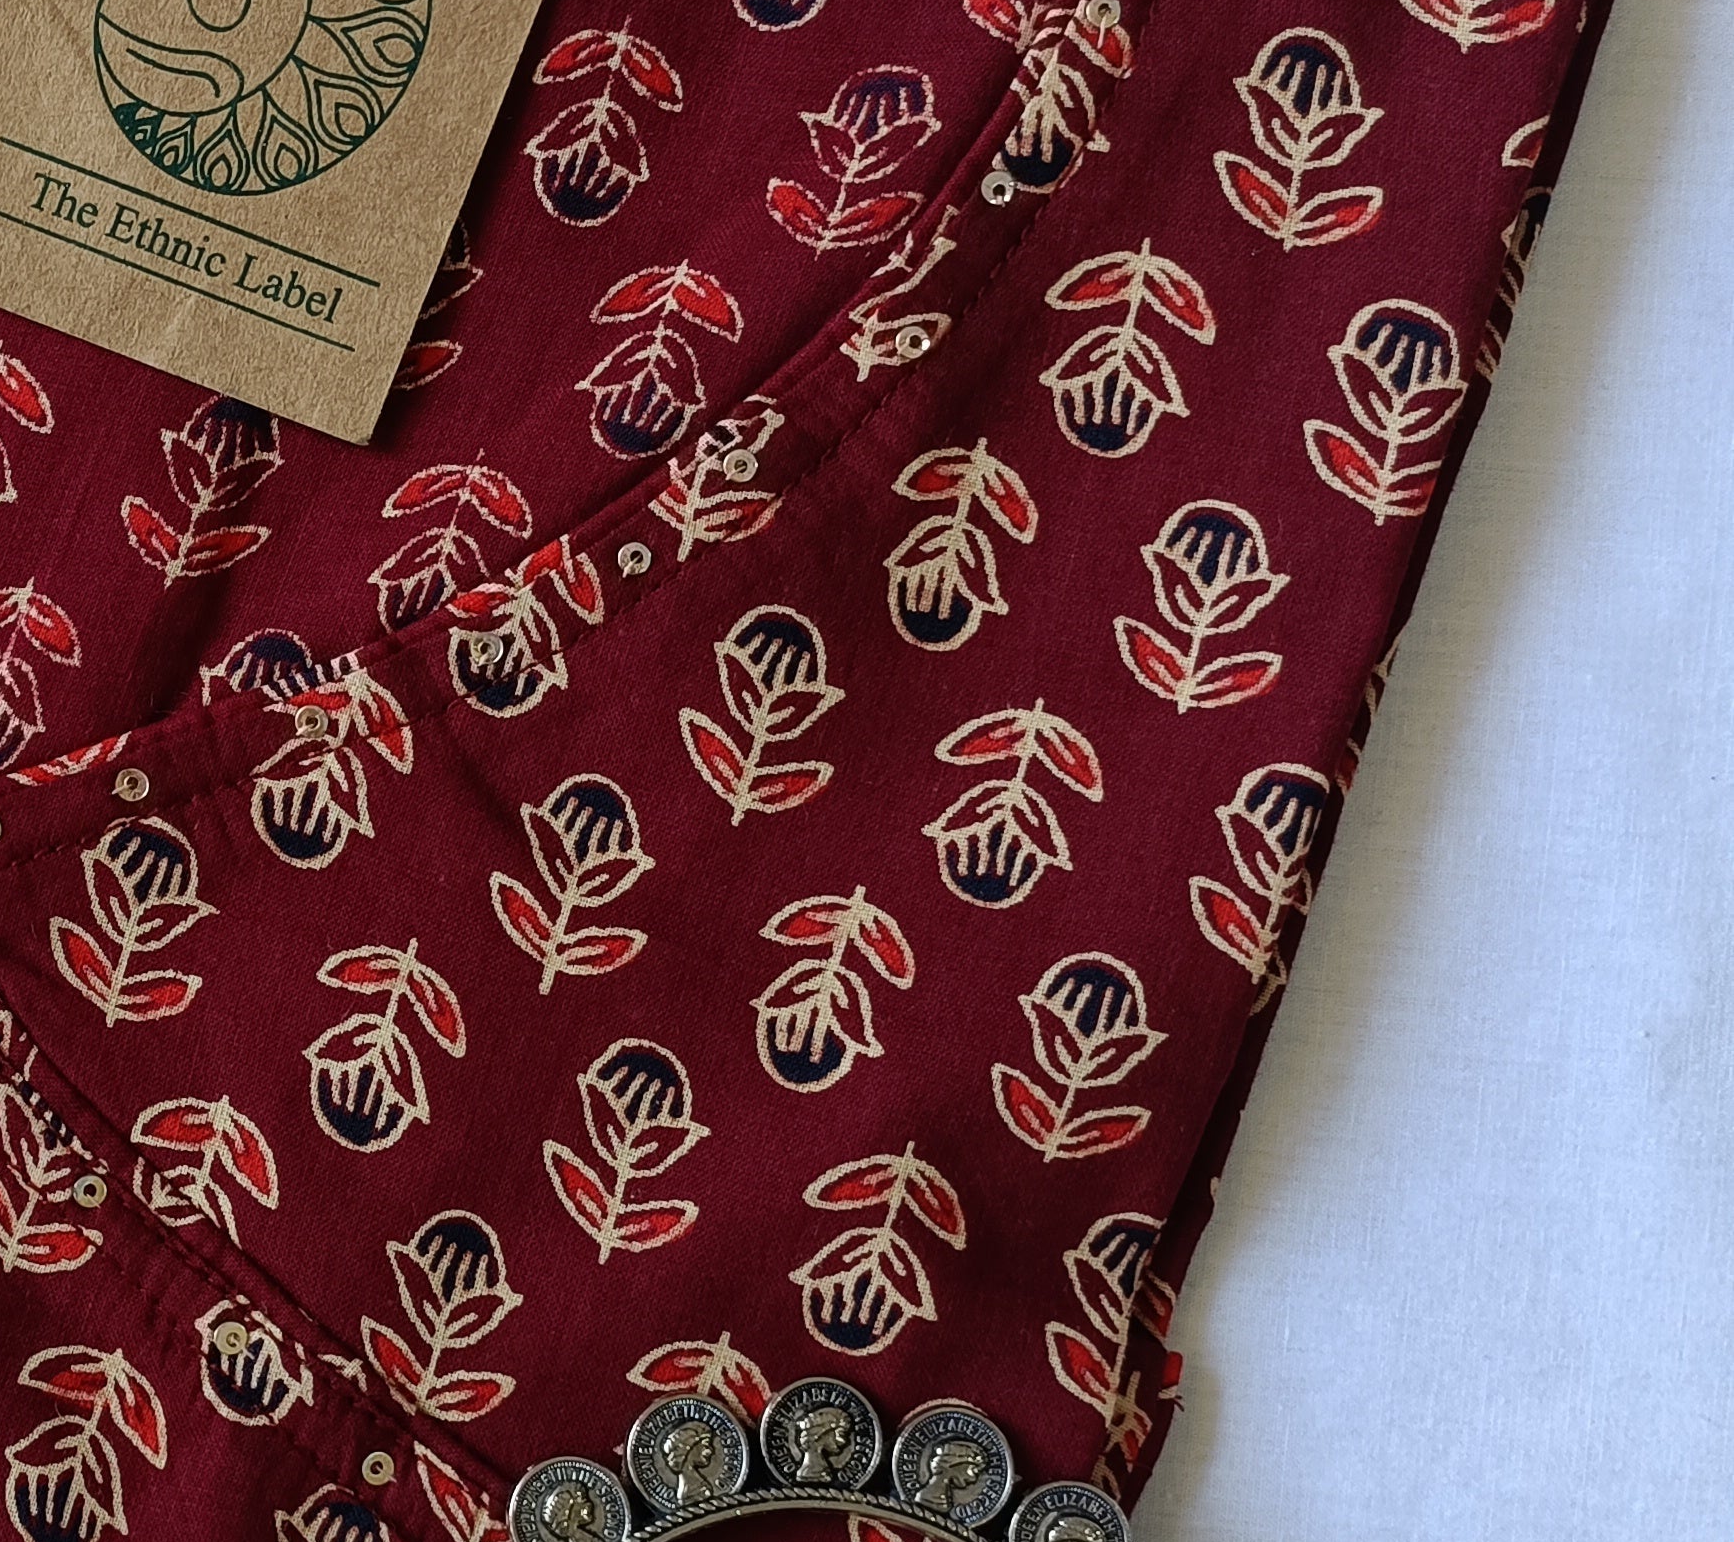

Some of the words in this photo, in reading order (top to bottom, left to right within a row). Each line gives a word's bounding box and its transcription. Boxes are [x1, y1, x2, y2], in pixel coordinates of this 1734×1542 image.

[30, 172, 99, 228] The
[105, 202, 227, 277] Ethnic
[233, 253, 343, 324] Label
